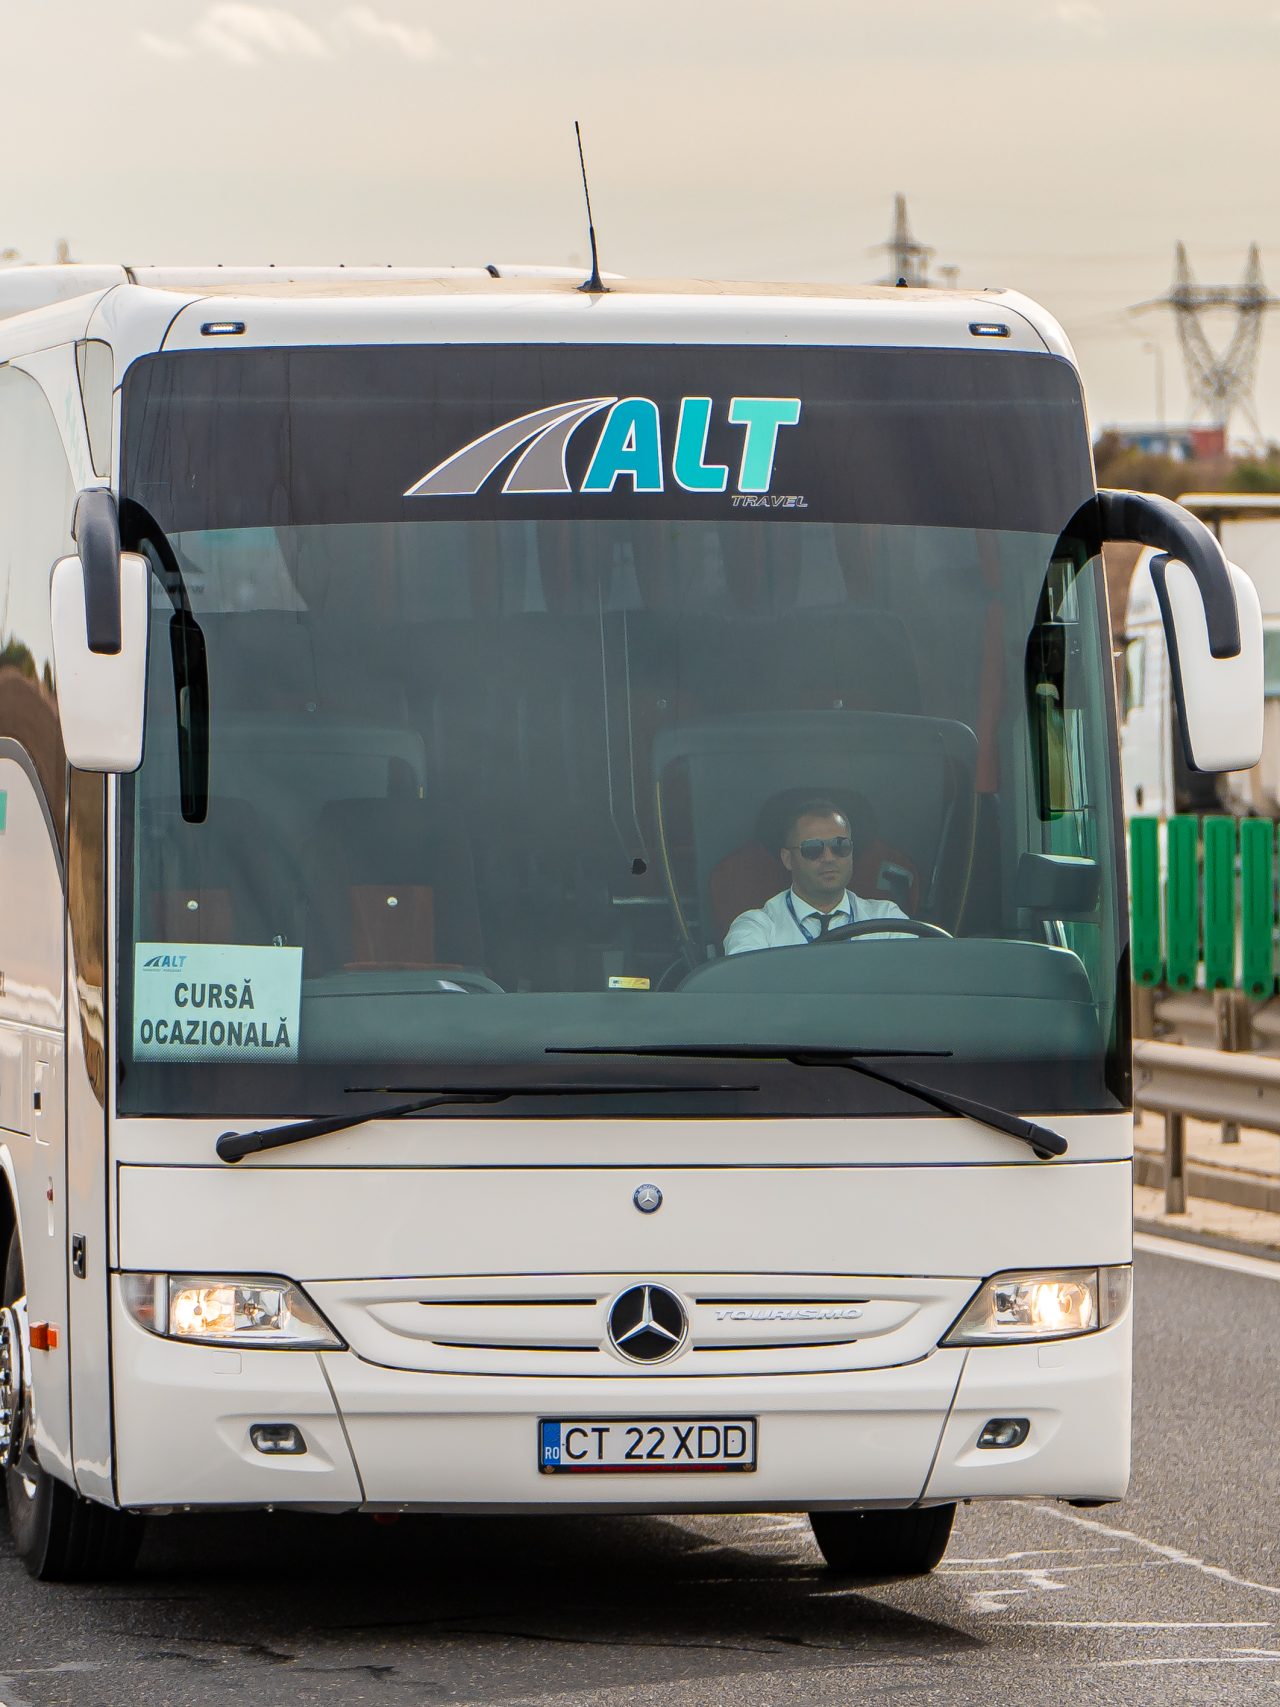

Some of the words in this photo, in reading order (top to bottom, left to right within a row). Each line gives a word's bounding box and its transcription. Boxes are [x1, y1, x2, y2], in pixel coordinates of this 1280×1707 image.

[580, 396, 801, 493] ALT
[731, 495, 809, 508] TRAVEL
[161, 955, 188, 968] ALT
[174, 978, 255, 1010] CURSĂ
[140, 1016, 291, 1048] OCAZIONALĂ
[715, 1307, 864, 1321] TOURISMO
[544, 1446, 560, 1460] RO
[565, 1427, 610, 1460] CT
